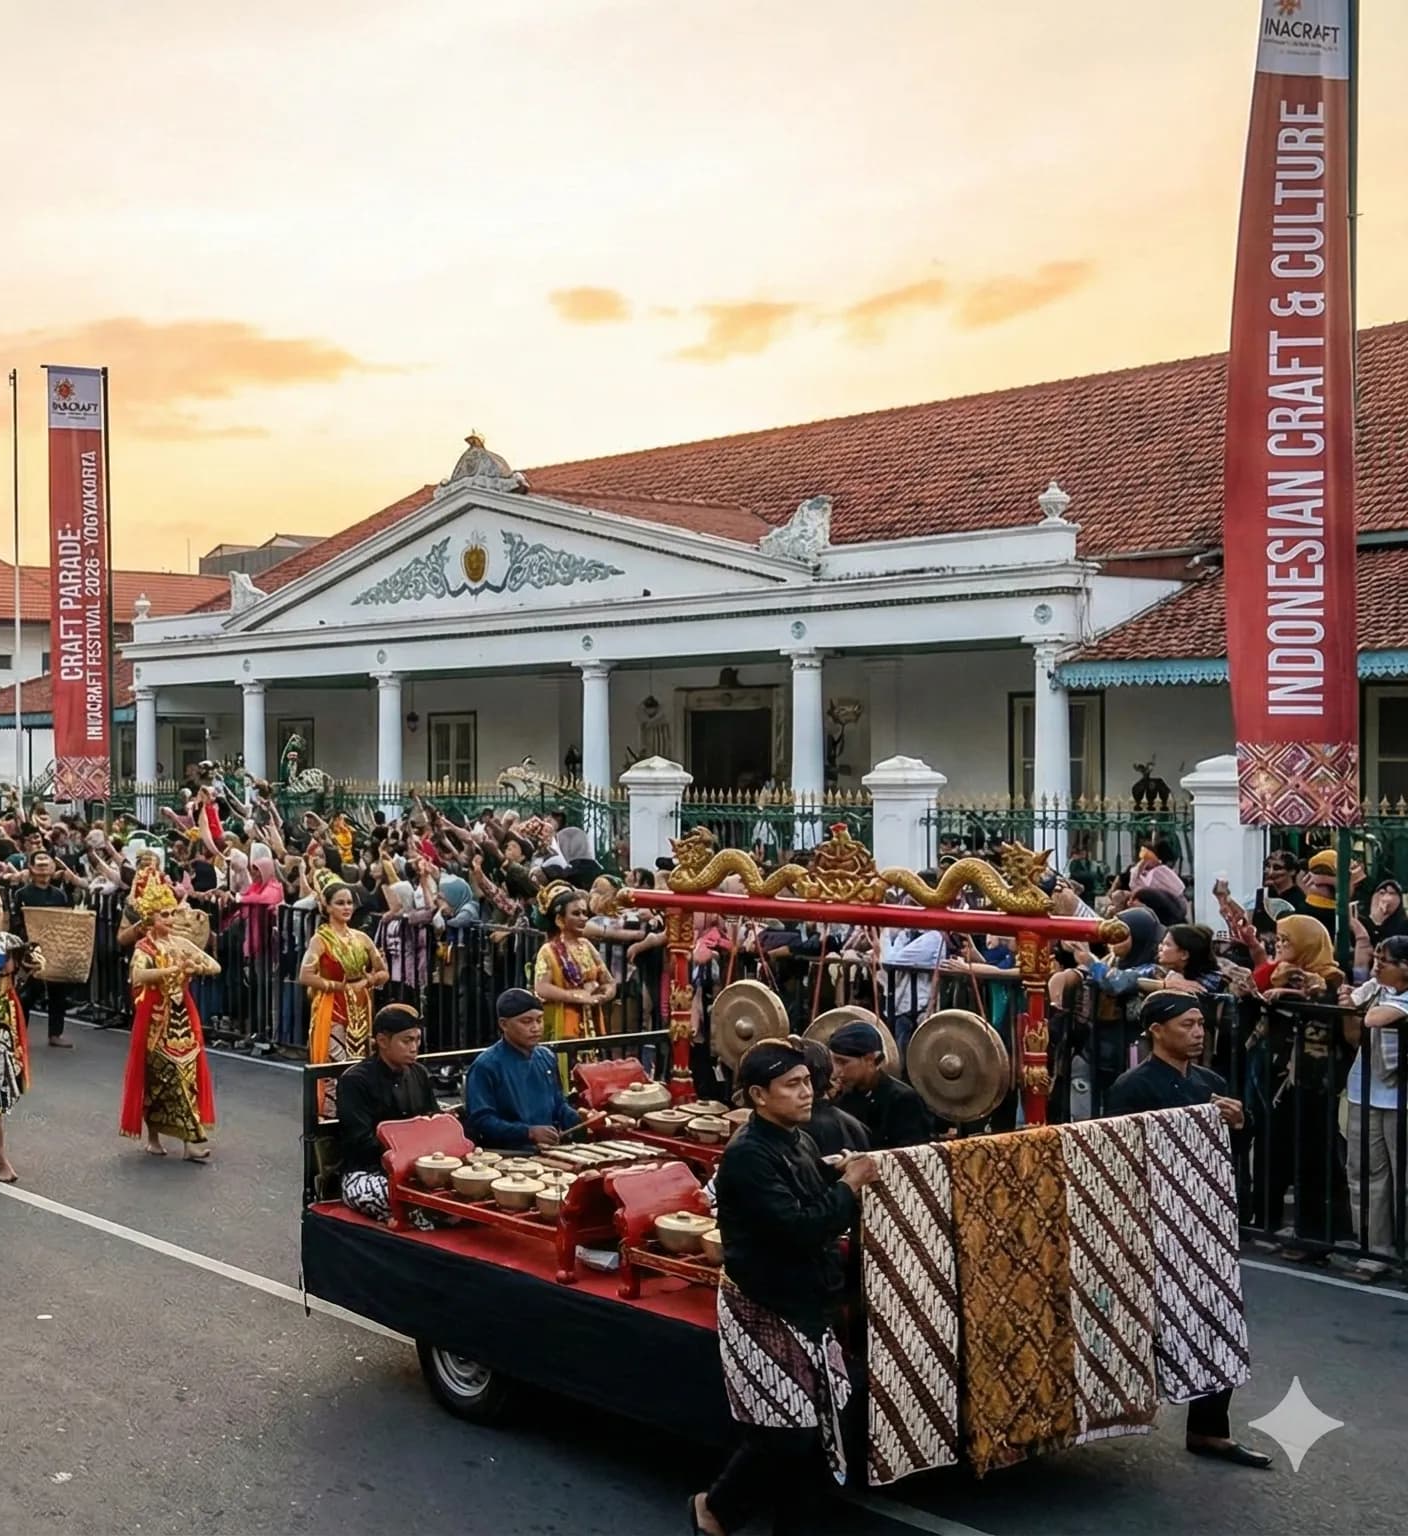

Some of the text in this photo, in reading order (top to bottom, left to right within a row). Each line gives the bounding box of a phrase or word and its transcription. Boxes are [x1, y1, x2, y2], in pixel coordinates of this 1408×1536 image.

[1264, 17, 1340, 43] INACRAFT
[1270, 100, 1325, 278] CULTURE
[1269, 290, 1325, 317] &
[1267, 330, 1325, 456] CRAFT
[81, 451, 99, 546] YOGYAKARTA
[85, 557, 100, 596] 2026
[1267, 471, 1325, 715] INDONESIAN
[59, 615, 83, 681] CRAFT
[86, 600, 102, 665] FESTIVAL
